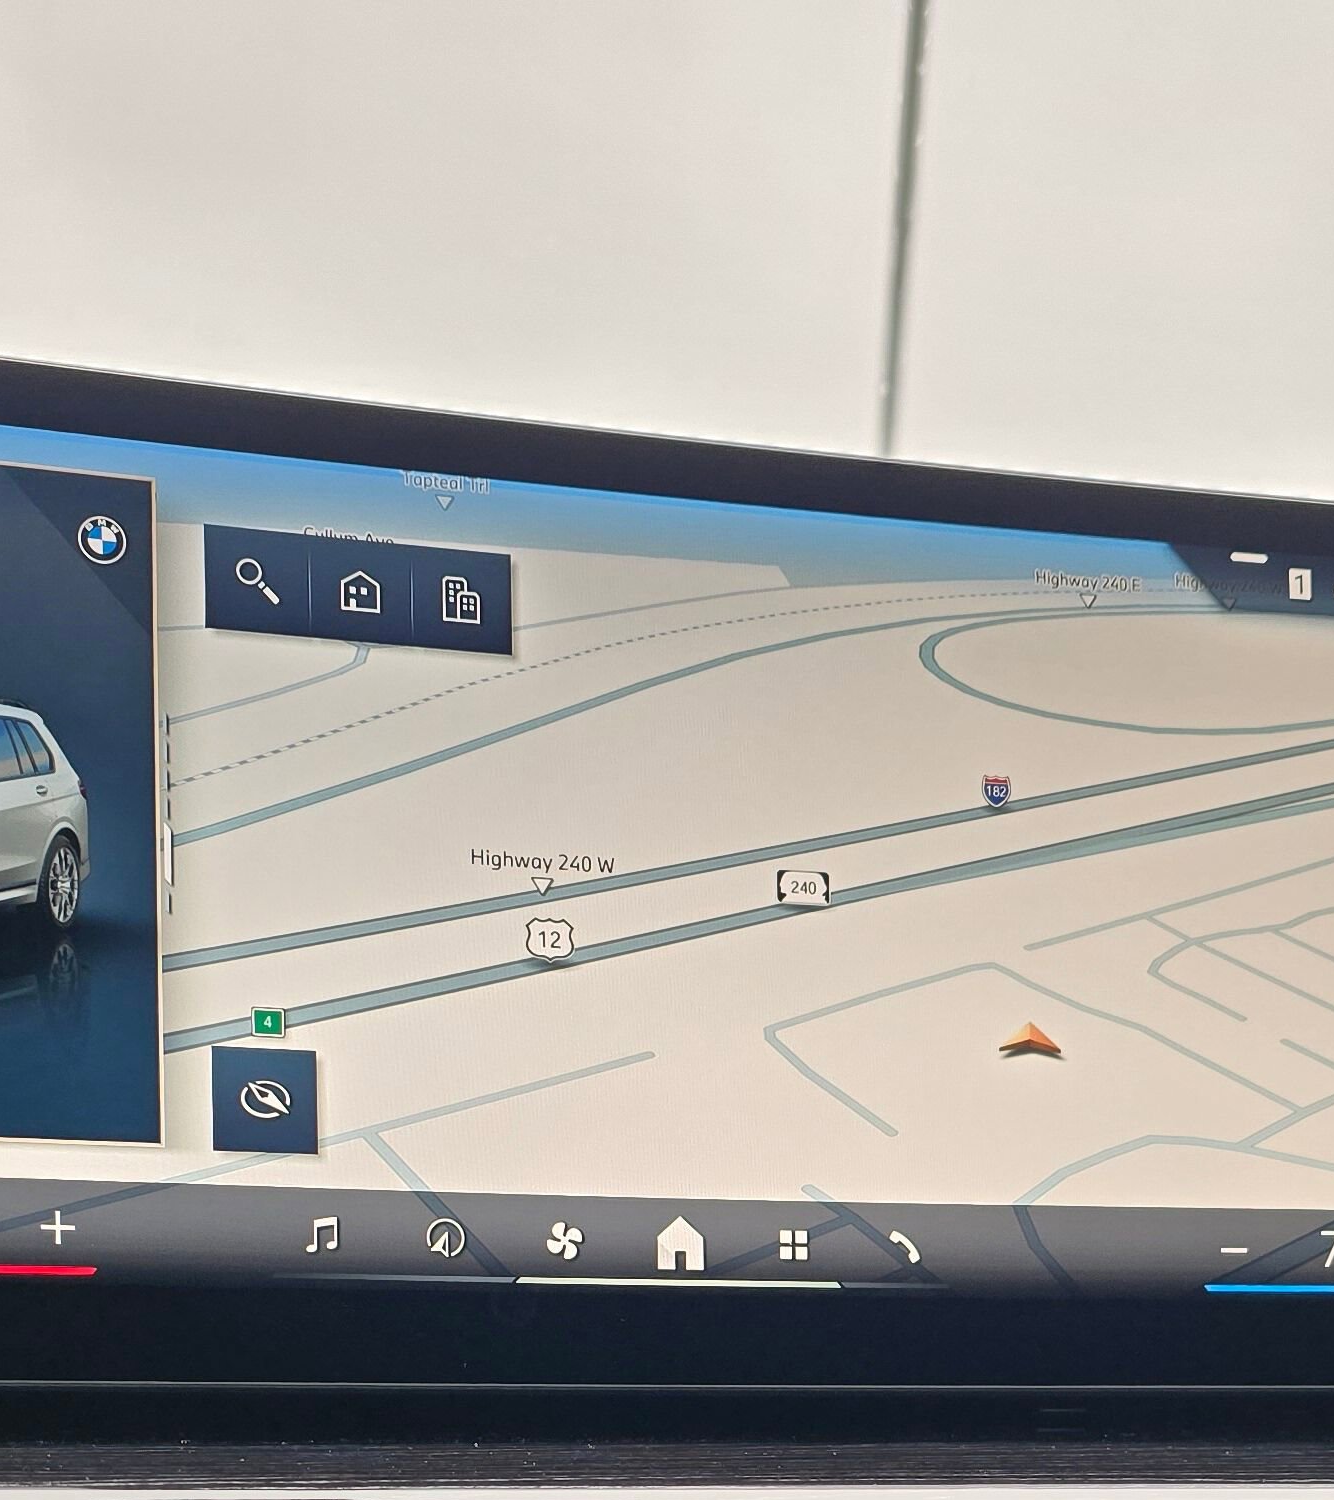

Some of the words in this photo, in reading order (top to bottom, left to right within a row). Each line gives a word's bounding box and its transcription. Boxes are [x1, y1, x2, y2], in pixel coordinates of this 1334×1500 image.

[402, 470, 464, 491] Tapteal
[1035, 570, 1097, 591] Highway
[1101, 574, 1127, 591] 240
[1130, 577, 1141, 592] E
[987, 785, 1006, 797] 182
[471, 849, 553, 873] Highway
[558, 854, 592, 872] 240
[597, 857, 615, 873] W
[790, 881, 817, 895] 240
[538, 931, 562, 949] 12
[263, 1016, 273, 1029] 4
